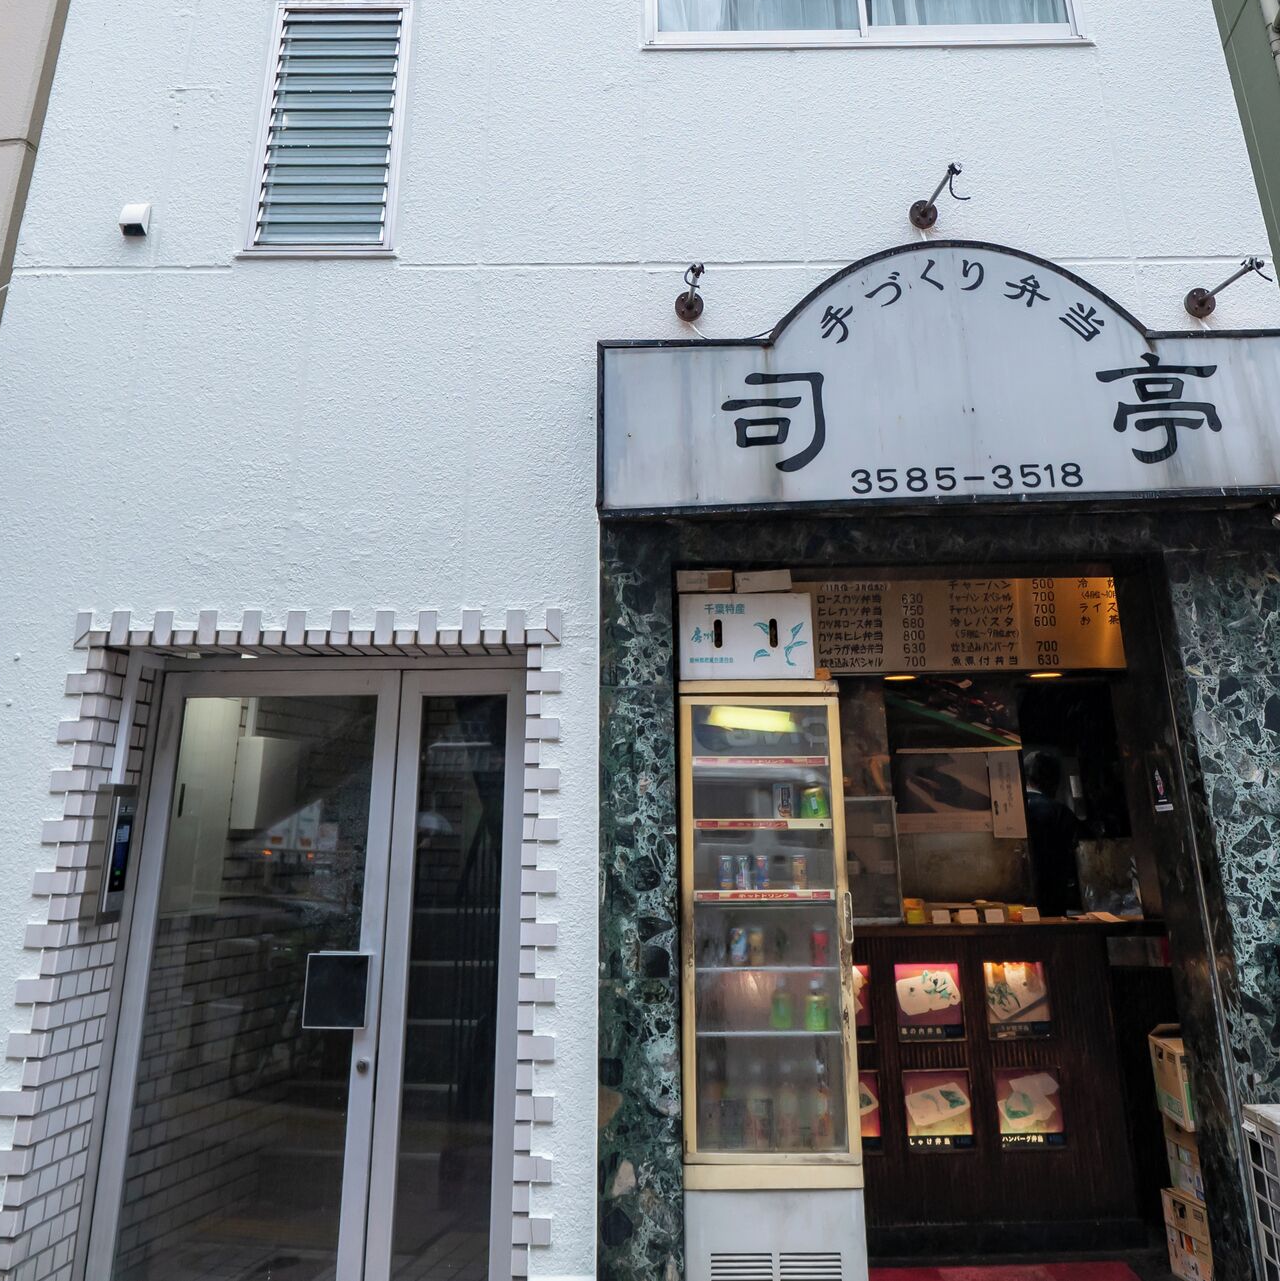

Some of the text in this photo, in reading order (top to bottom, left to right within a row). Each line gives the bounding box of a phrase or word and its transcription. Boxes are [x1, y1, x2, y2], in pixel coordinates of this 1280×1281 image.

[820, 258, 1106, 345] 手づくり弁当
[721, 353, 1224, 472] 司 亭
[850, 462, 1084, 495] 3585-3518
[949, 580, 1012, 590] チャーハン
[1031, 578, 1055, 589] 500
[816, 594, 881, 604] ロースカツ弁当
[901, 593, 924, 604] 630
[1032, 591, 1055, 602] 700
[1079, 602, 1118, 613] ライス
[704, 603, 746, 615] 千葉特産
[818, 607, 882, 616] ヒレカツ弁当
[903, 605, 925, 616] 750
[1033, 604, 1056, 614] 700
[902, 618, 925, 629] 680
[1034, 616, 1057, 627] 600
[903, 630, 926, 641] 800
[819, 643, 884, 655] しょうが焼き弁当
[903, 642, 926, 654] 630
[1036, 640, 1058, 652] 700
[904, 656, 926, 667] 700
[1037, 654, 1059, 665] 630
